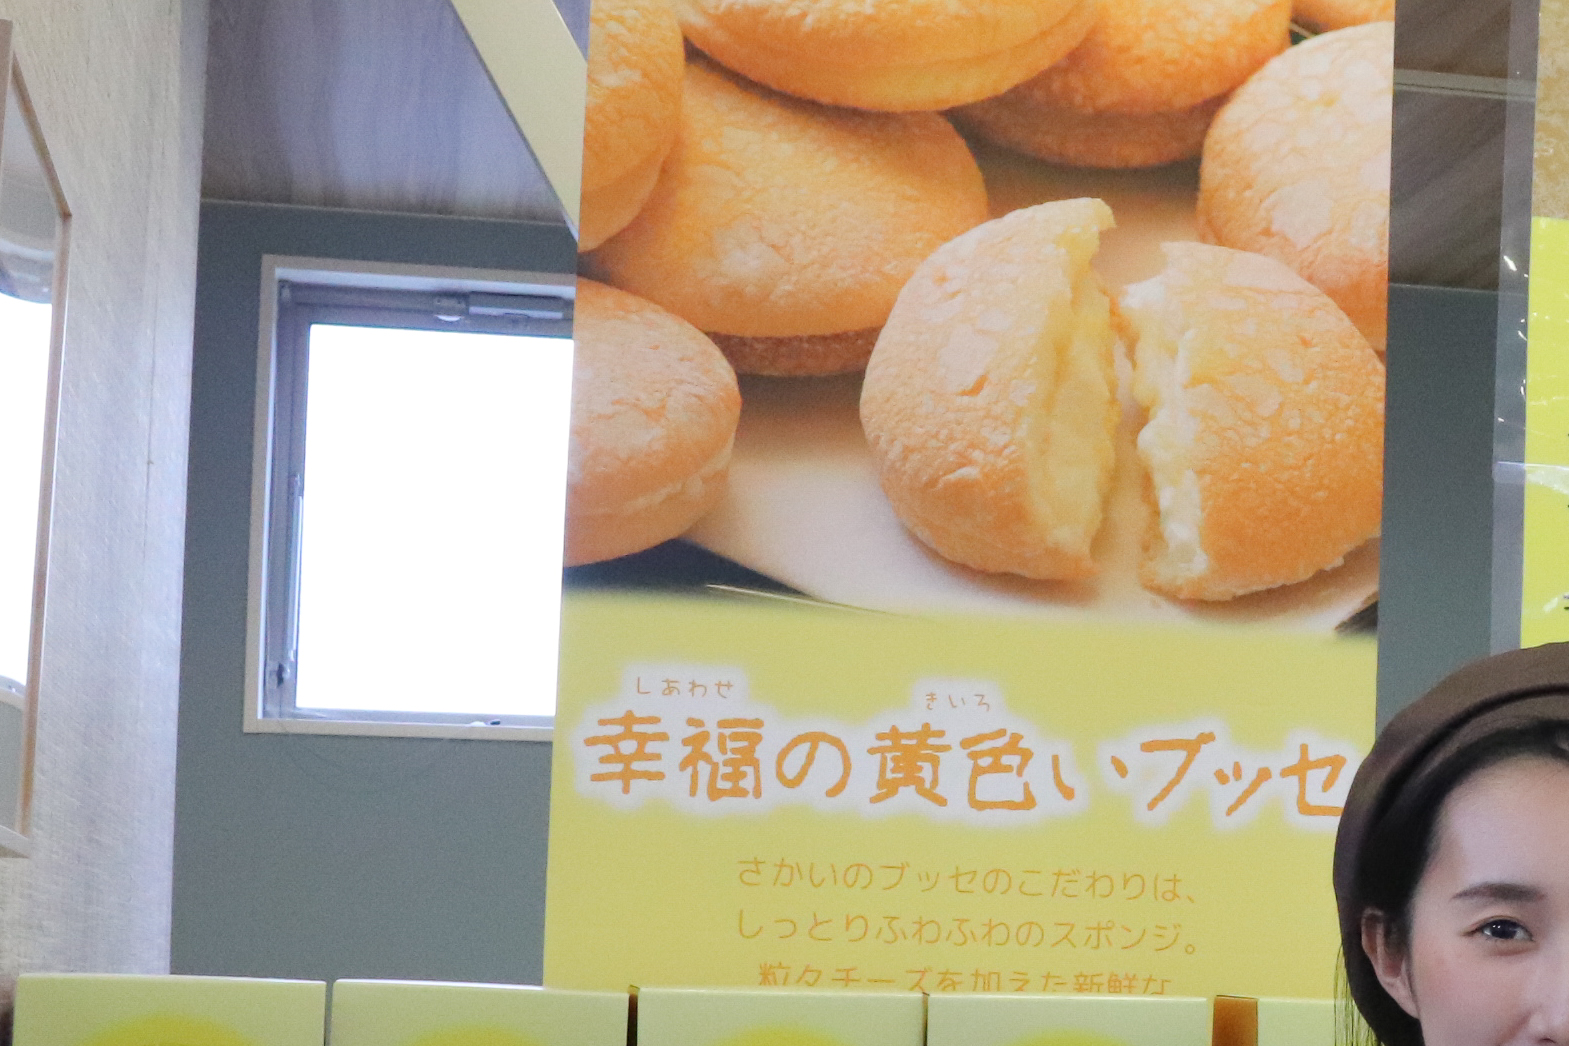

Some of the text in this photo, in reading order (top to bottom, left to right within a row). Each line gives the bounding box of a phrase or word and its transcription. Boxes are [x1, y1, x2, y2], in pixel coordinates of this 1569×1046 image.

[635, 676, 735, 699] しあわせ
[924, 691, 992, 713] きいろ
[583, 708, 1344, 817] 幸福の黄色いブッセ
[736, 855, 1197, 905] さかいのブッセのこだわりは、
[736, 911, 1199, 956] しっとりふわふわのスポンジ。
